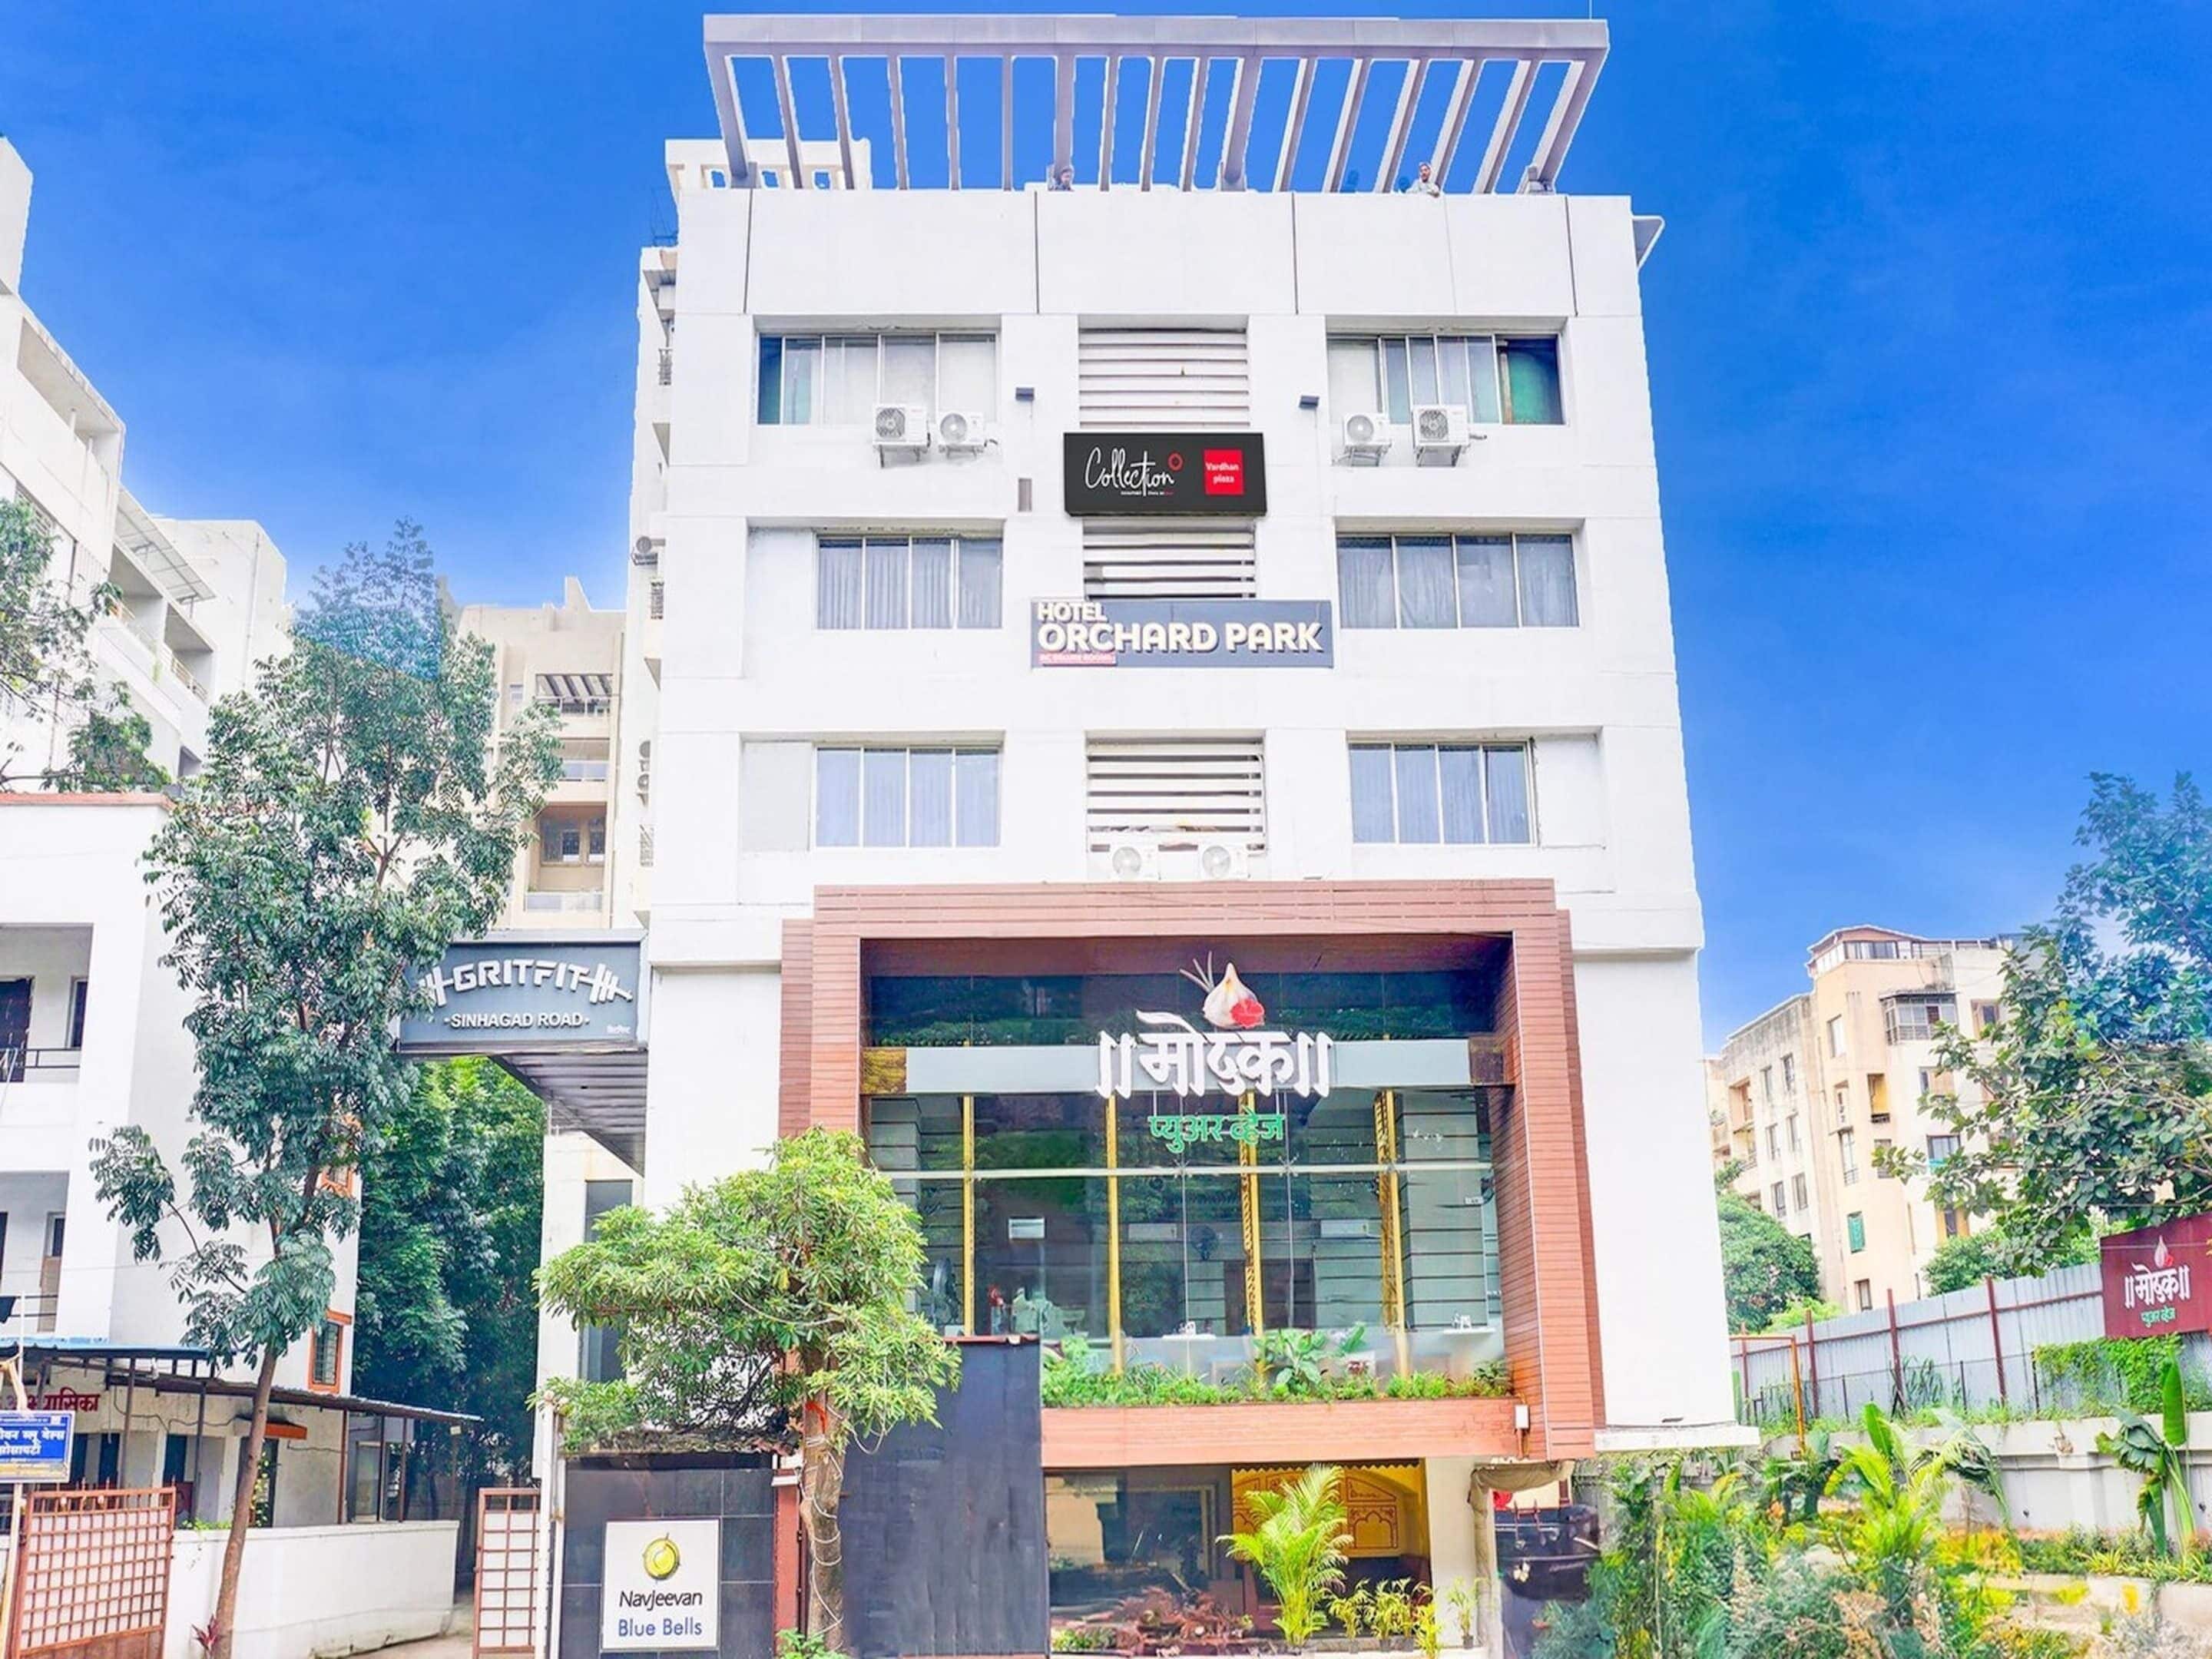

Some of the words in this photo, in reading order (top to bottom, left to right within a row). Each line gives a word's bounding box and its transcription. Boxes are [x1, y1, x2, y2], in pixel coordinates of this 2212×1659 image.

[1085, 446, 1175, 497] Collection
[1213, 473, 1235, 485] plaza
[1038, 602, 1108, 621] HOTEL
[1038, 622, 1217, 652] ORCHARD
[1225, 622, 1323, 652] PARK
[452, 959, 590, 992] GRITFIT
[619, 1589, 703, 1611] Navjeevan
[618, 1618, 656, 1637] Blue
[663, 1617, 703, 1635] Bells
